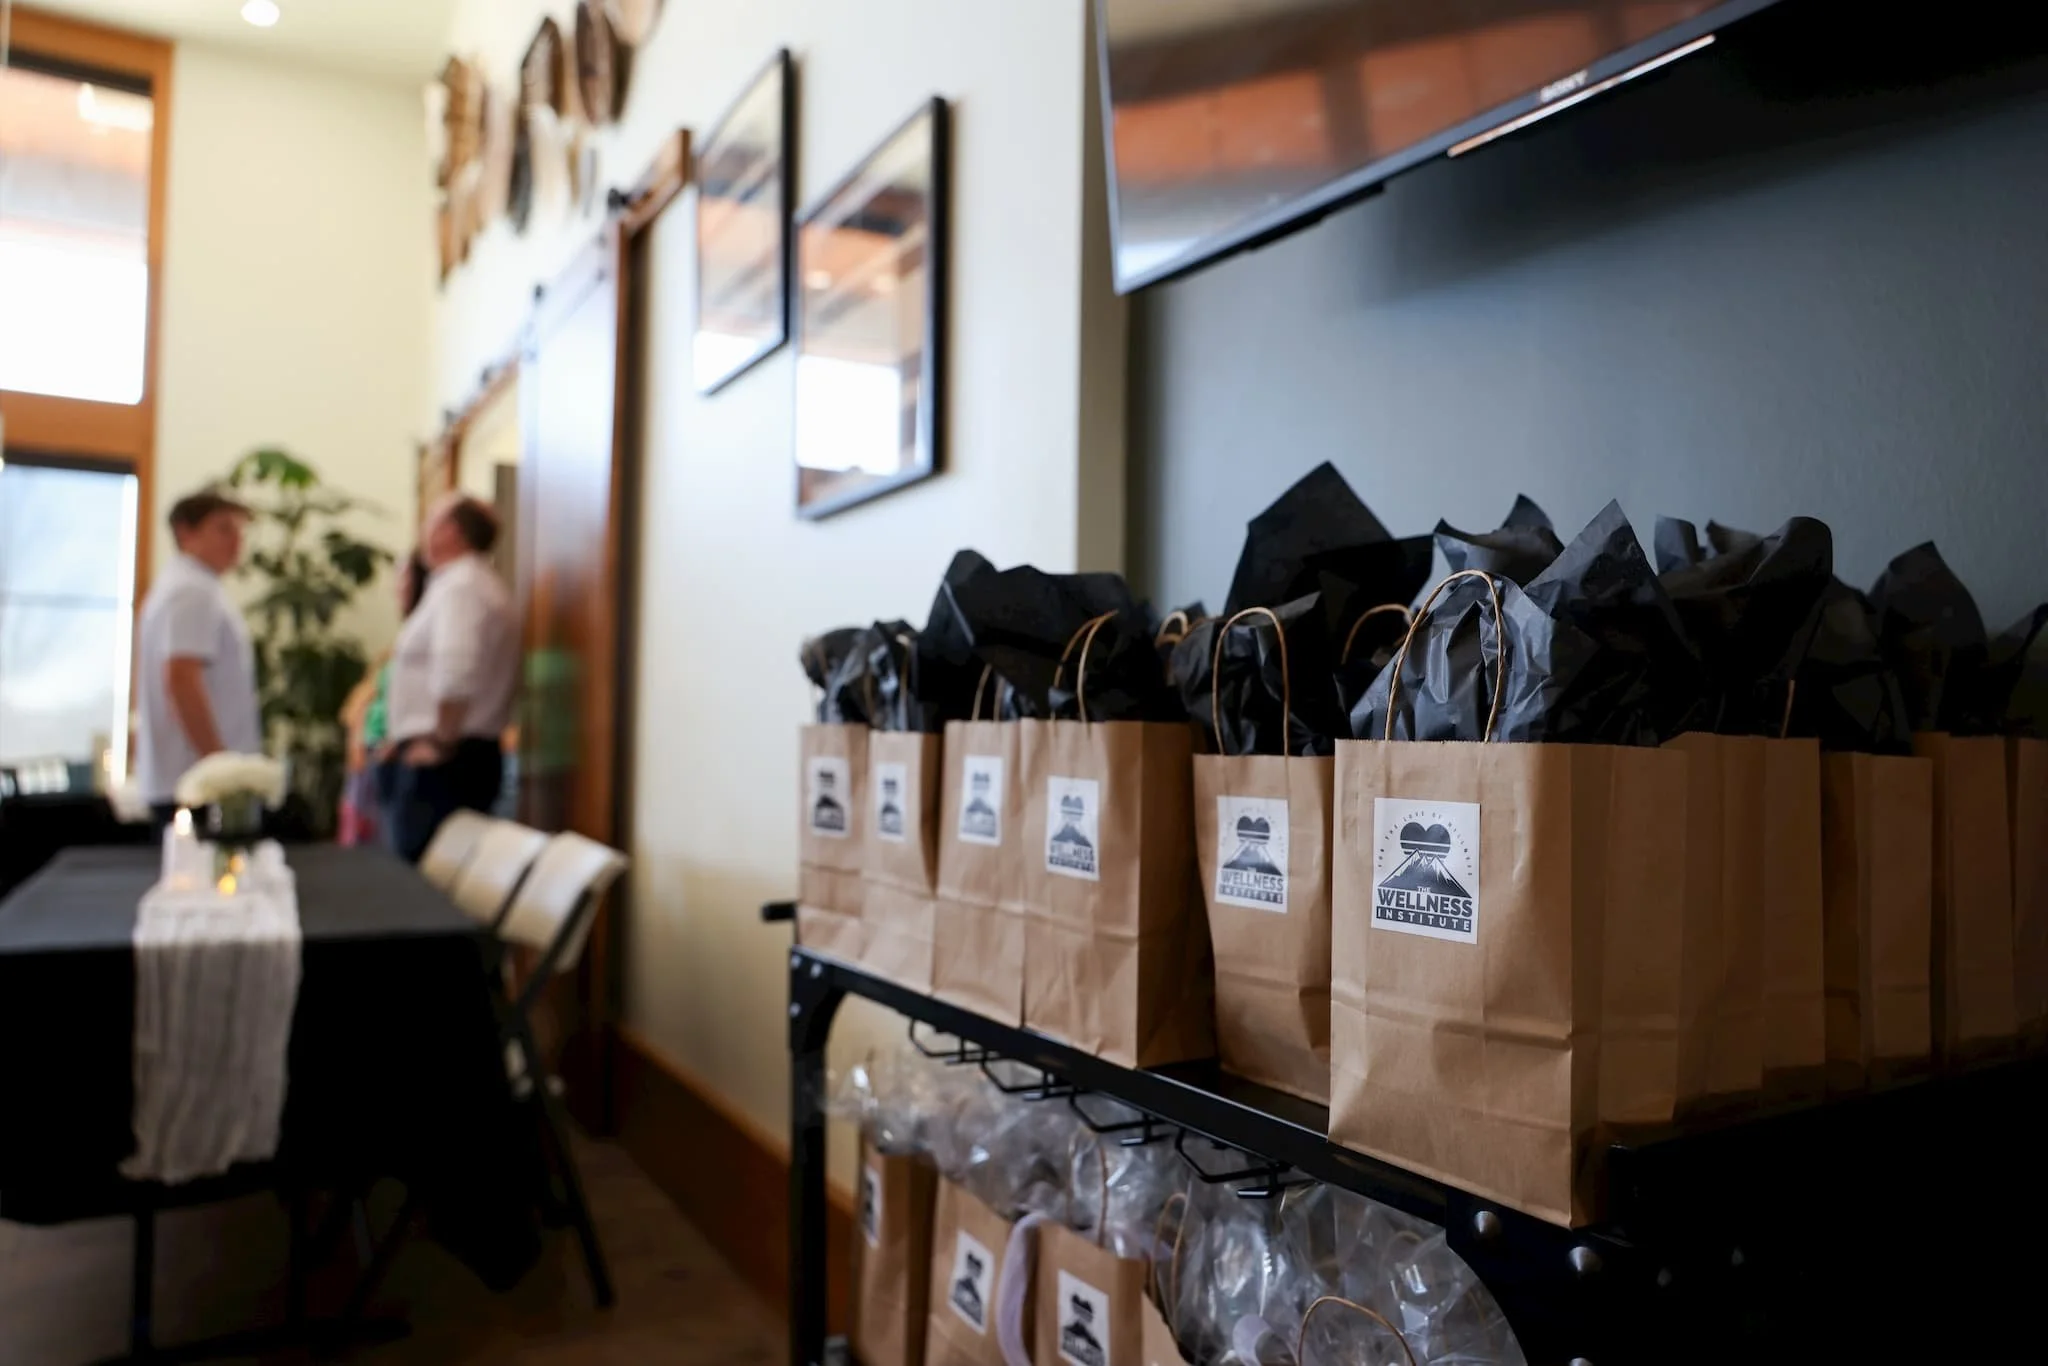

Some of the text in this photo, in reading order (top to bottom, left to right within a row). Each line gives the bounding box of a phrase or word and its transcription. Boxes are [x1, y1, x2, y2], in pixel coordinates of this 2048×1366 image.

[1221, 870, 1284, 891] WELLNESS
[1377, 888, 1472, 917] WELLNESS
[1377, 909, 1470, 930] INSTITUTE
